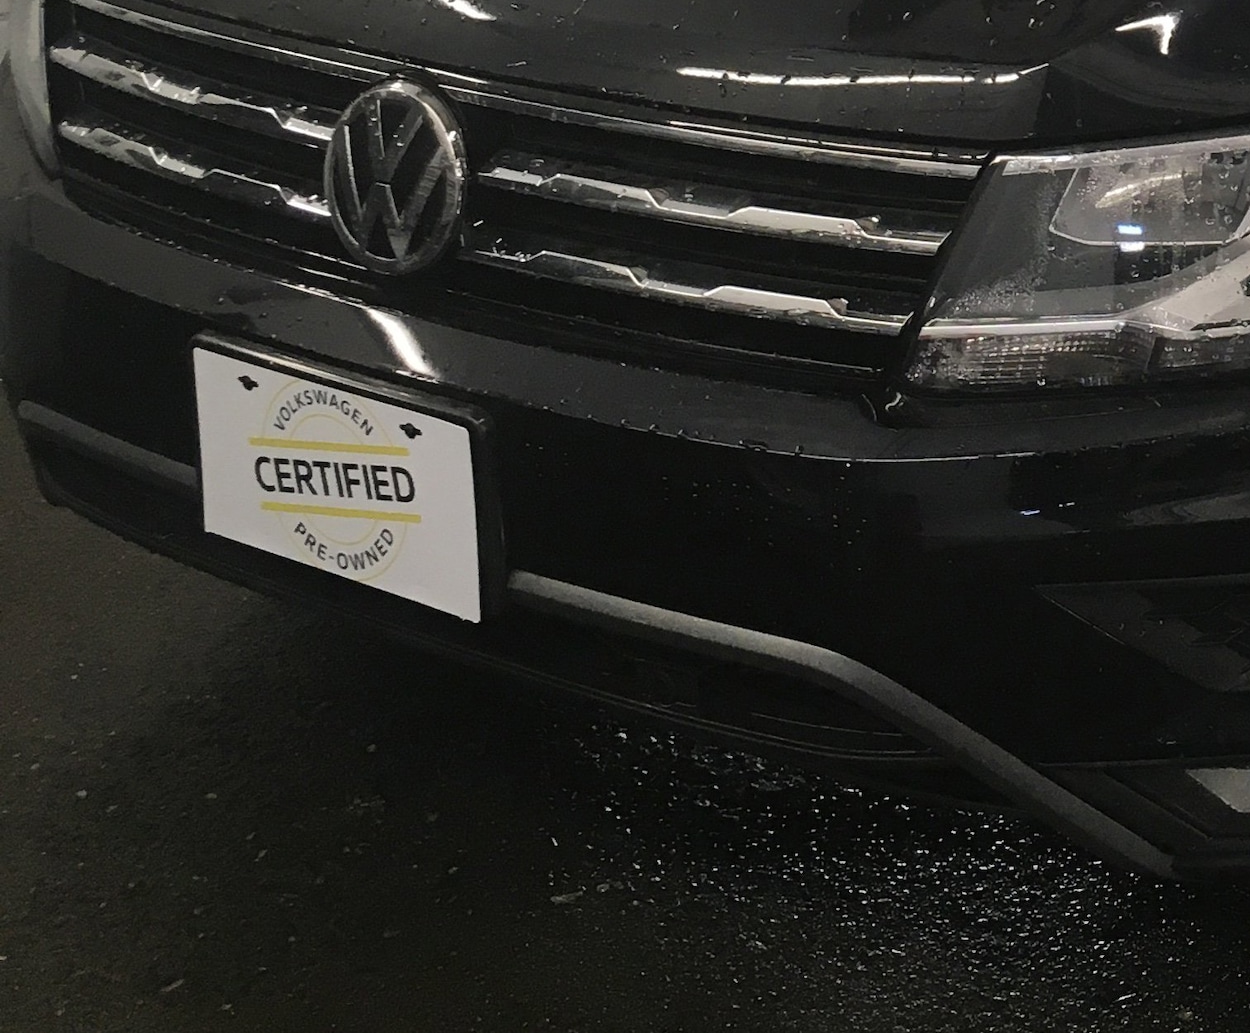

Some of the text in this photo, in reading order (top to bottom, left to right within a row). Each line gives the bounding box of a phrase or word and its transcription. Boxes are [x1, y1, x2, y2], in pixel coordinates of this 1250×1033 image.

[273, 389, 374, 436] VOLKSWAGEN
[255, 456, 416, 503] CERTIFIED
[294, 522, 394, 571] PRE-OWNED
